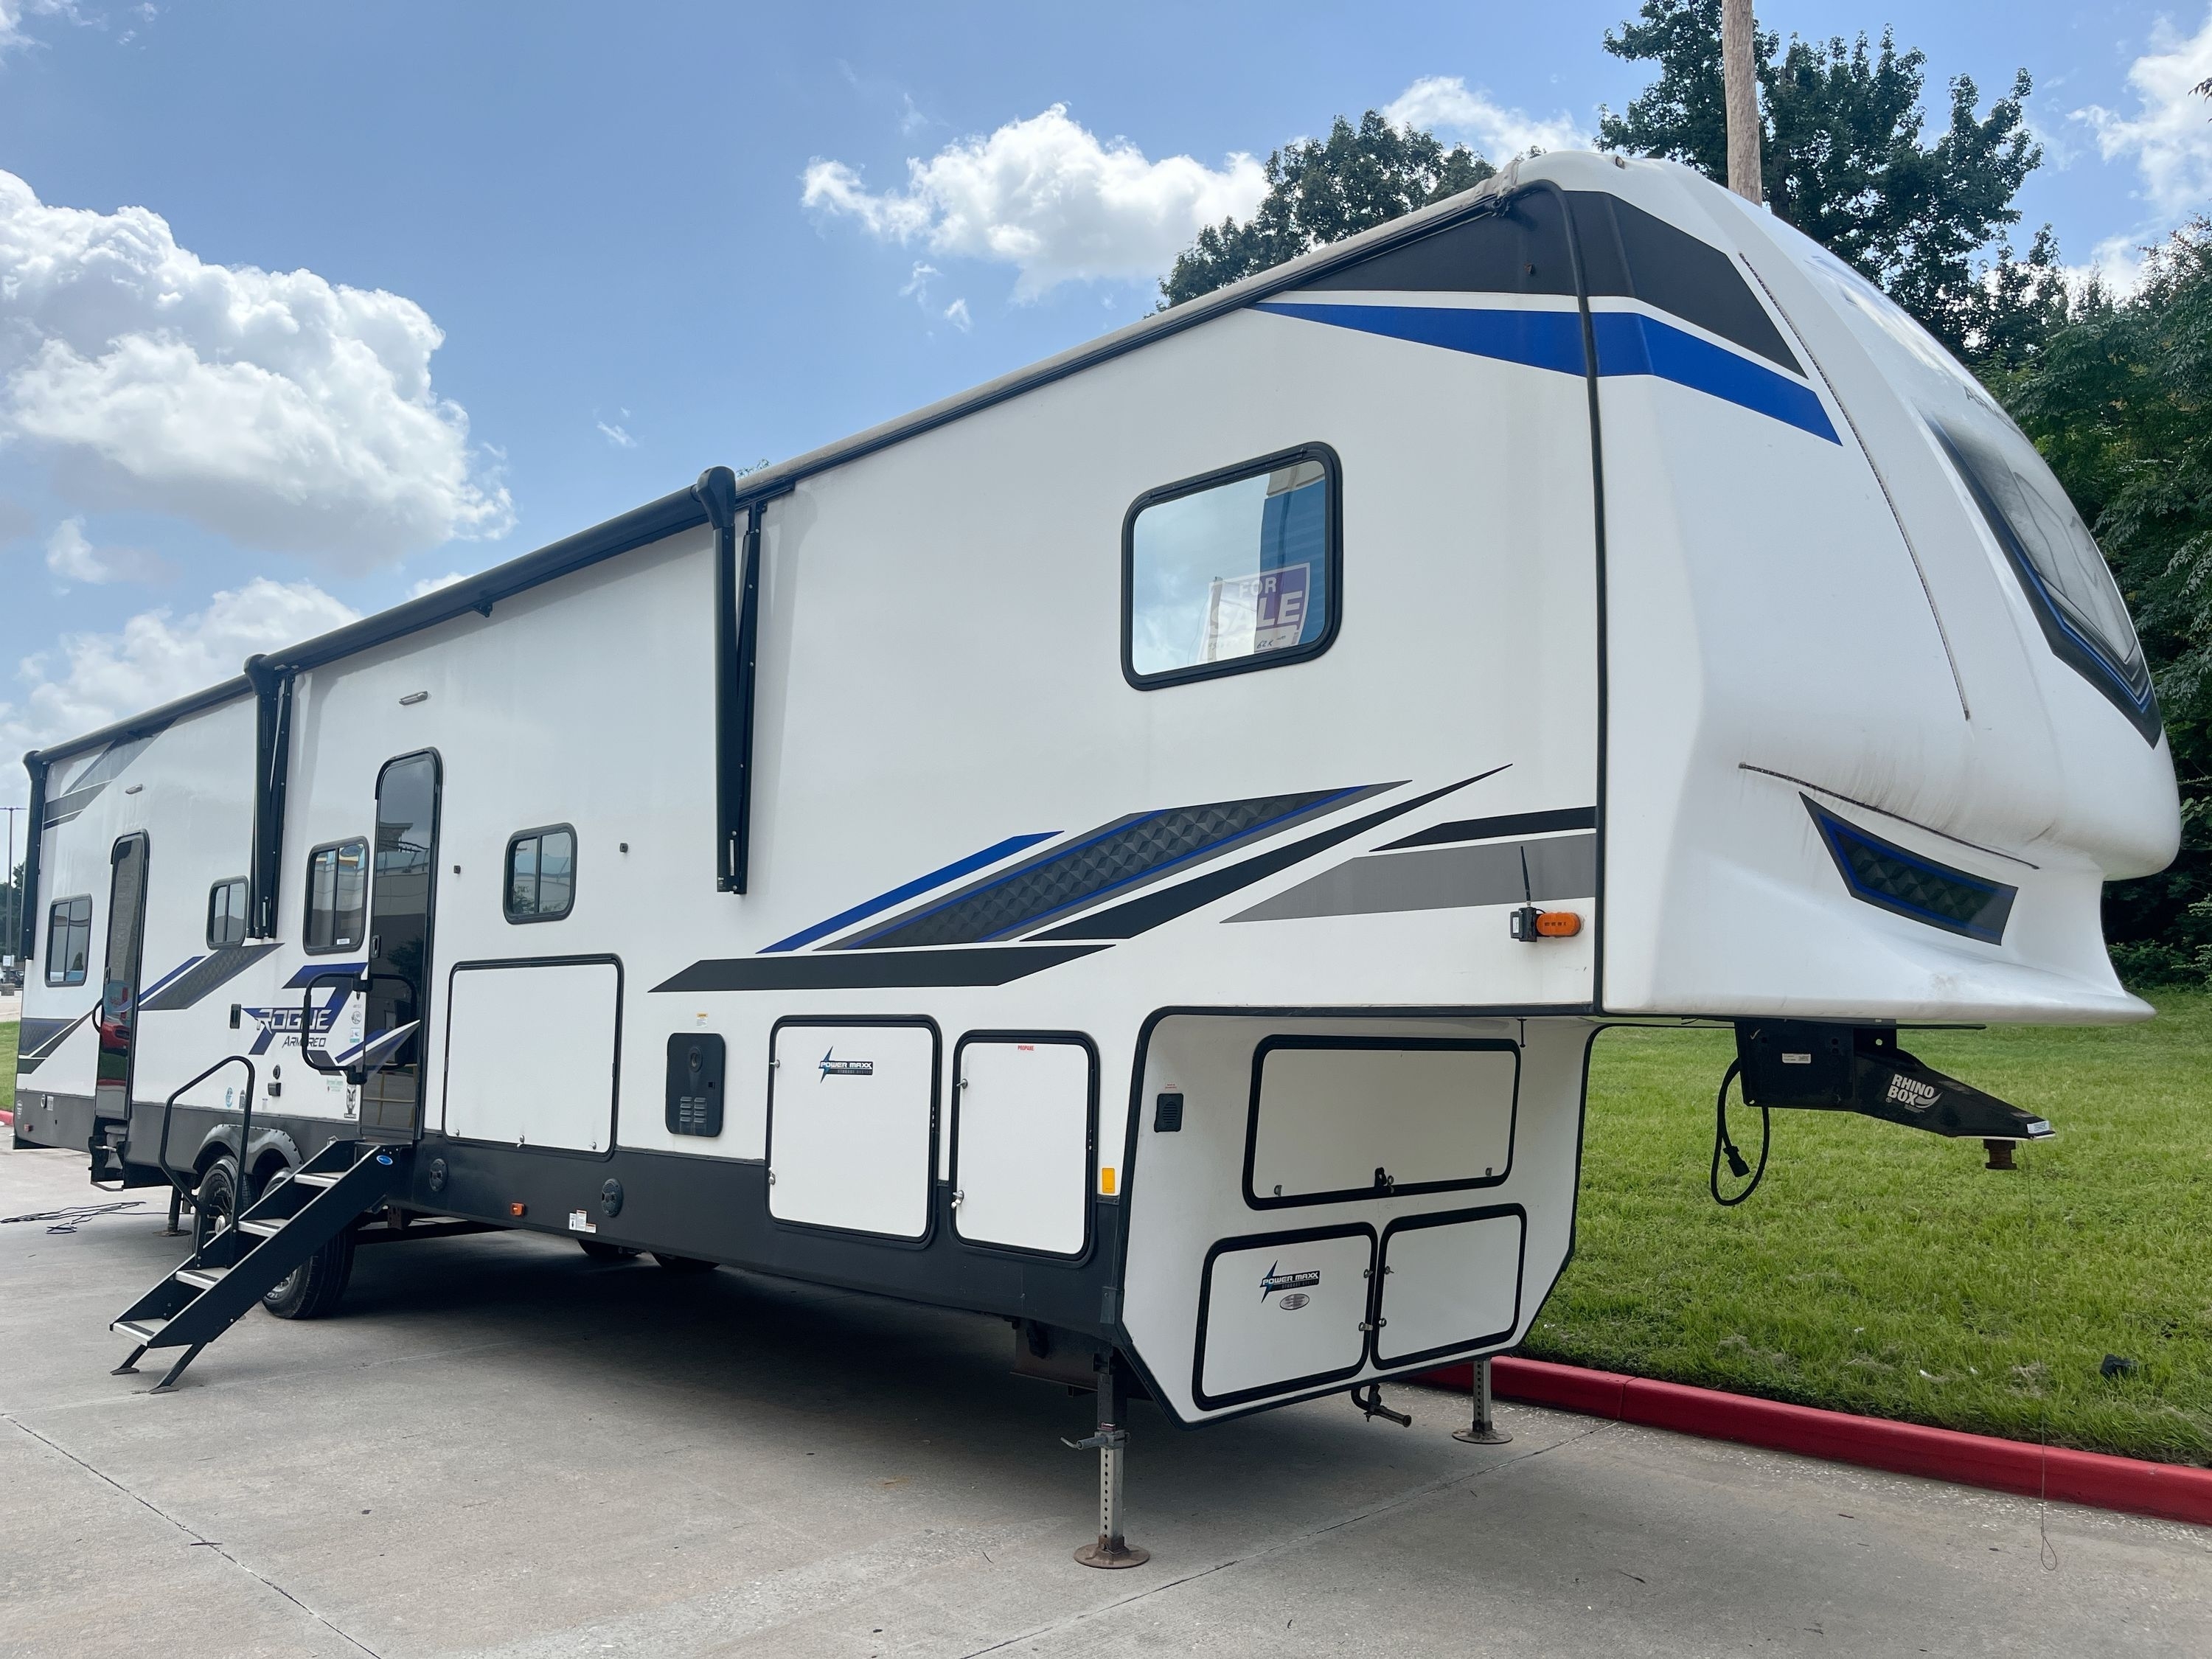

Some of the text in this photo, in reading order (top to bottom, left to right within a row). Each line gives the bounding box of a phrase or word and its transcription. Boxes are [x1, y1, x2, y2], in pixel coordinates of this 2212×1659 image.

[1239, 577, 1277, 598] FOR
[1210, 591, 1303, 636] SALE
[282, 1035, 327, 1048] ARMRED
[1888, 1085, 1918, 1106] BOX
[1891, 1074, 1935, 1099] RHINO
[1263, 1272, 1318, 1285] POWER MAXX
